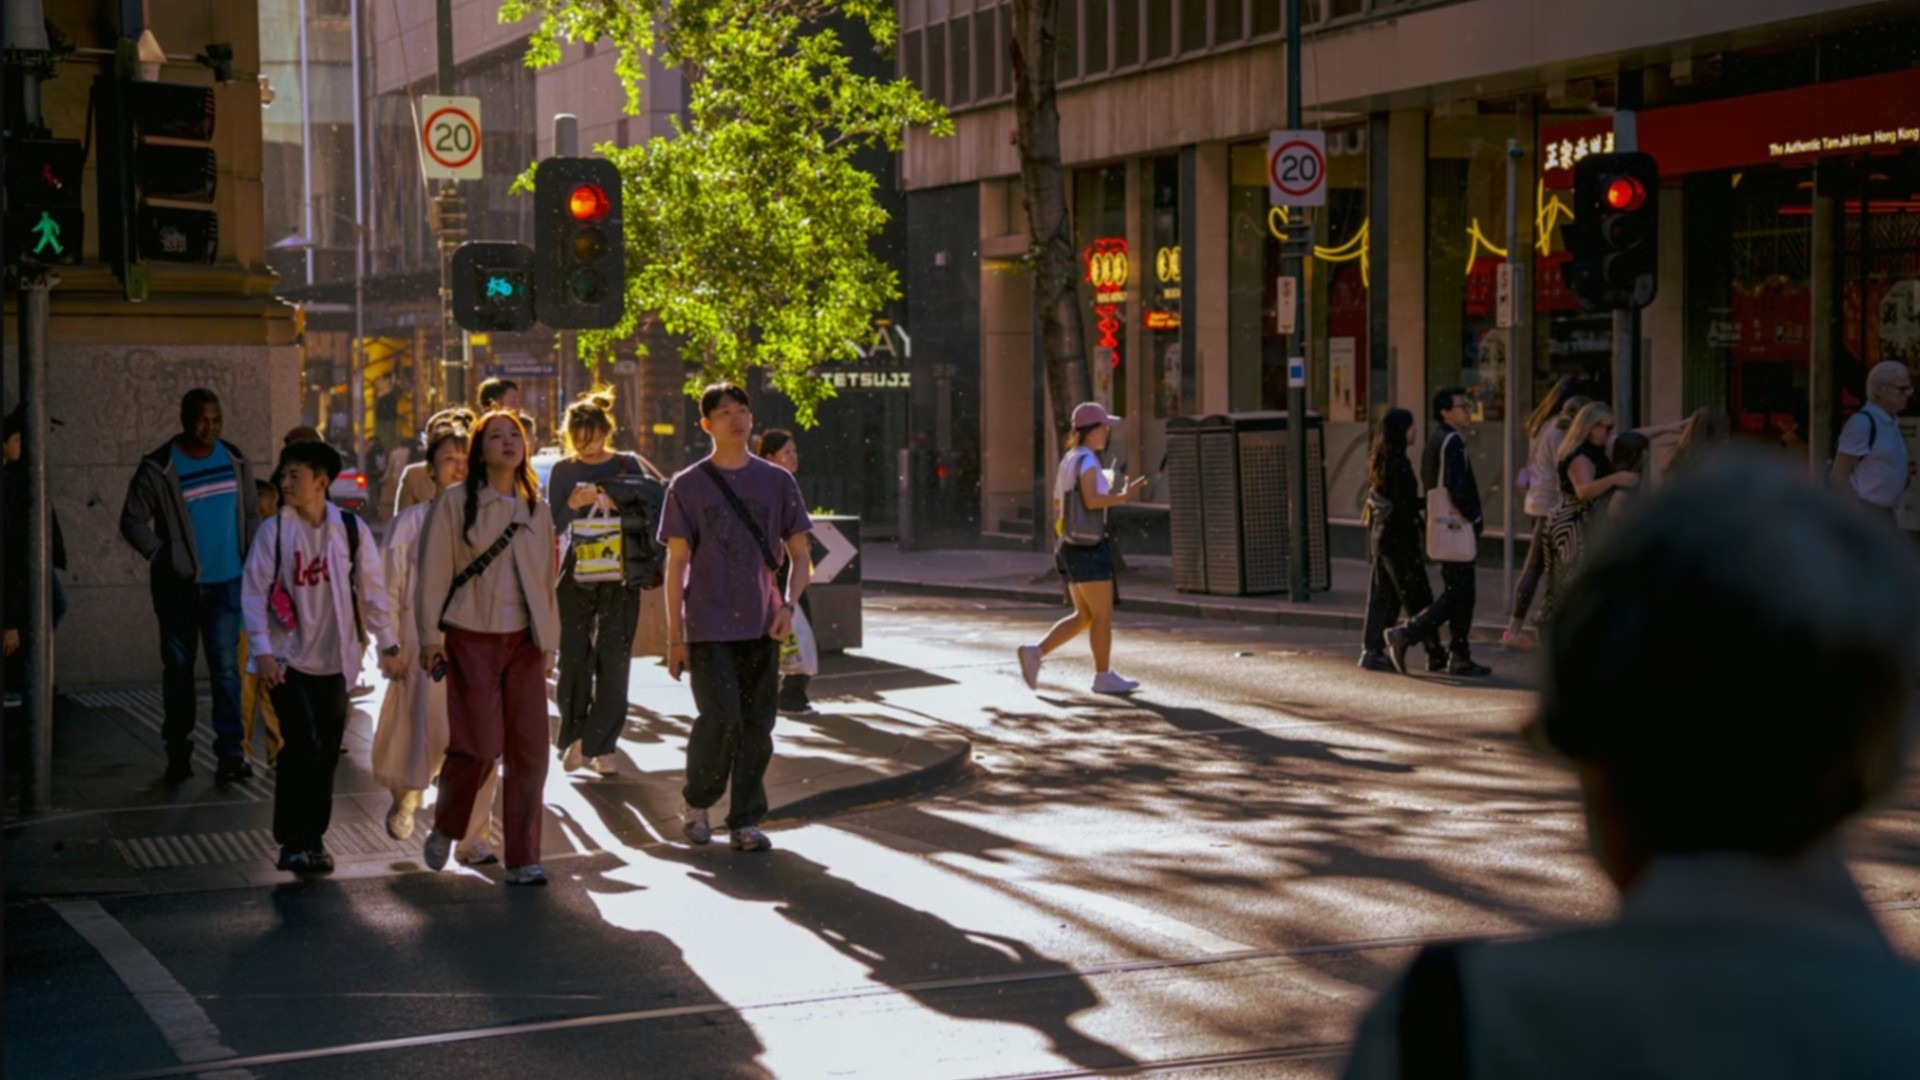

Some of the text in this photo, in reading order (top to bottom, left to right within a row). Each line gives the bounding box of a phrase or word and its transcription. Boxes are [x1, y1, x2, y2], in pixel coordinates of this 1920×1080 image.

[435, 123, 473, 152] 20
[1769, 143, 1784, 156] The
[1785, 138, 1820, 154] Authentic
[1874, 130, 1897, 144] Hong
[1897, 127, 1920, 142] Kong
[1281, 155, 1317, 182] 20
[821, 372, 911, 388] TETSUJI
